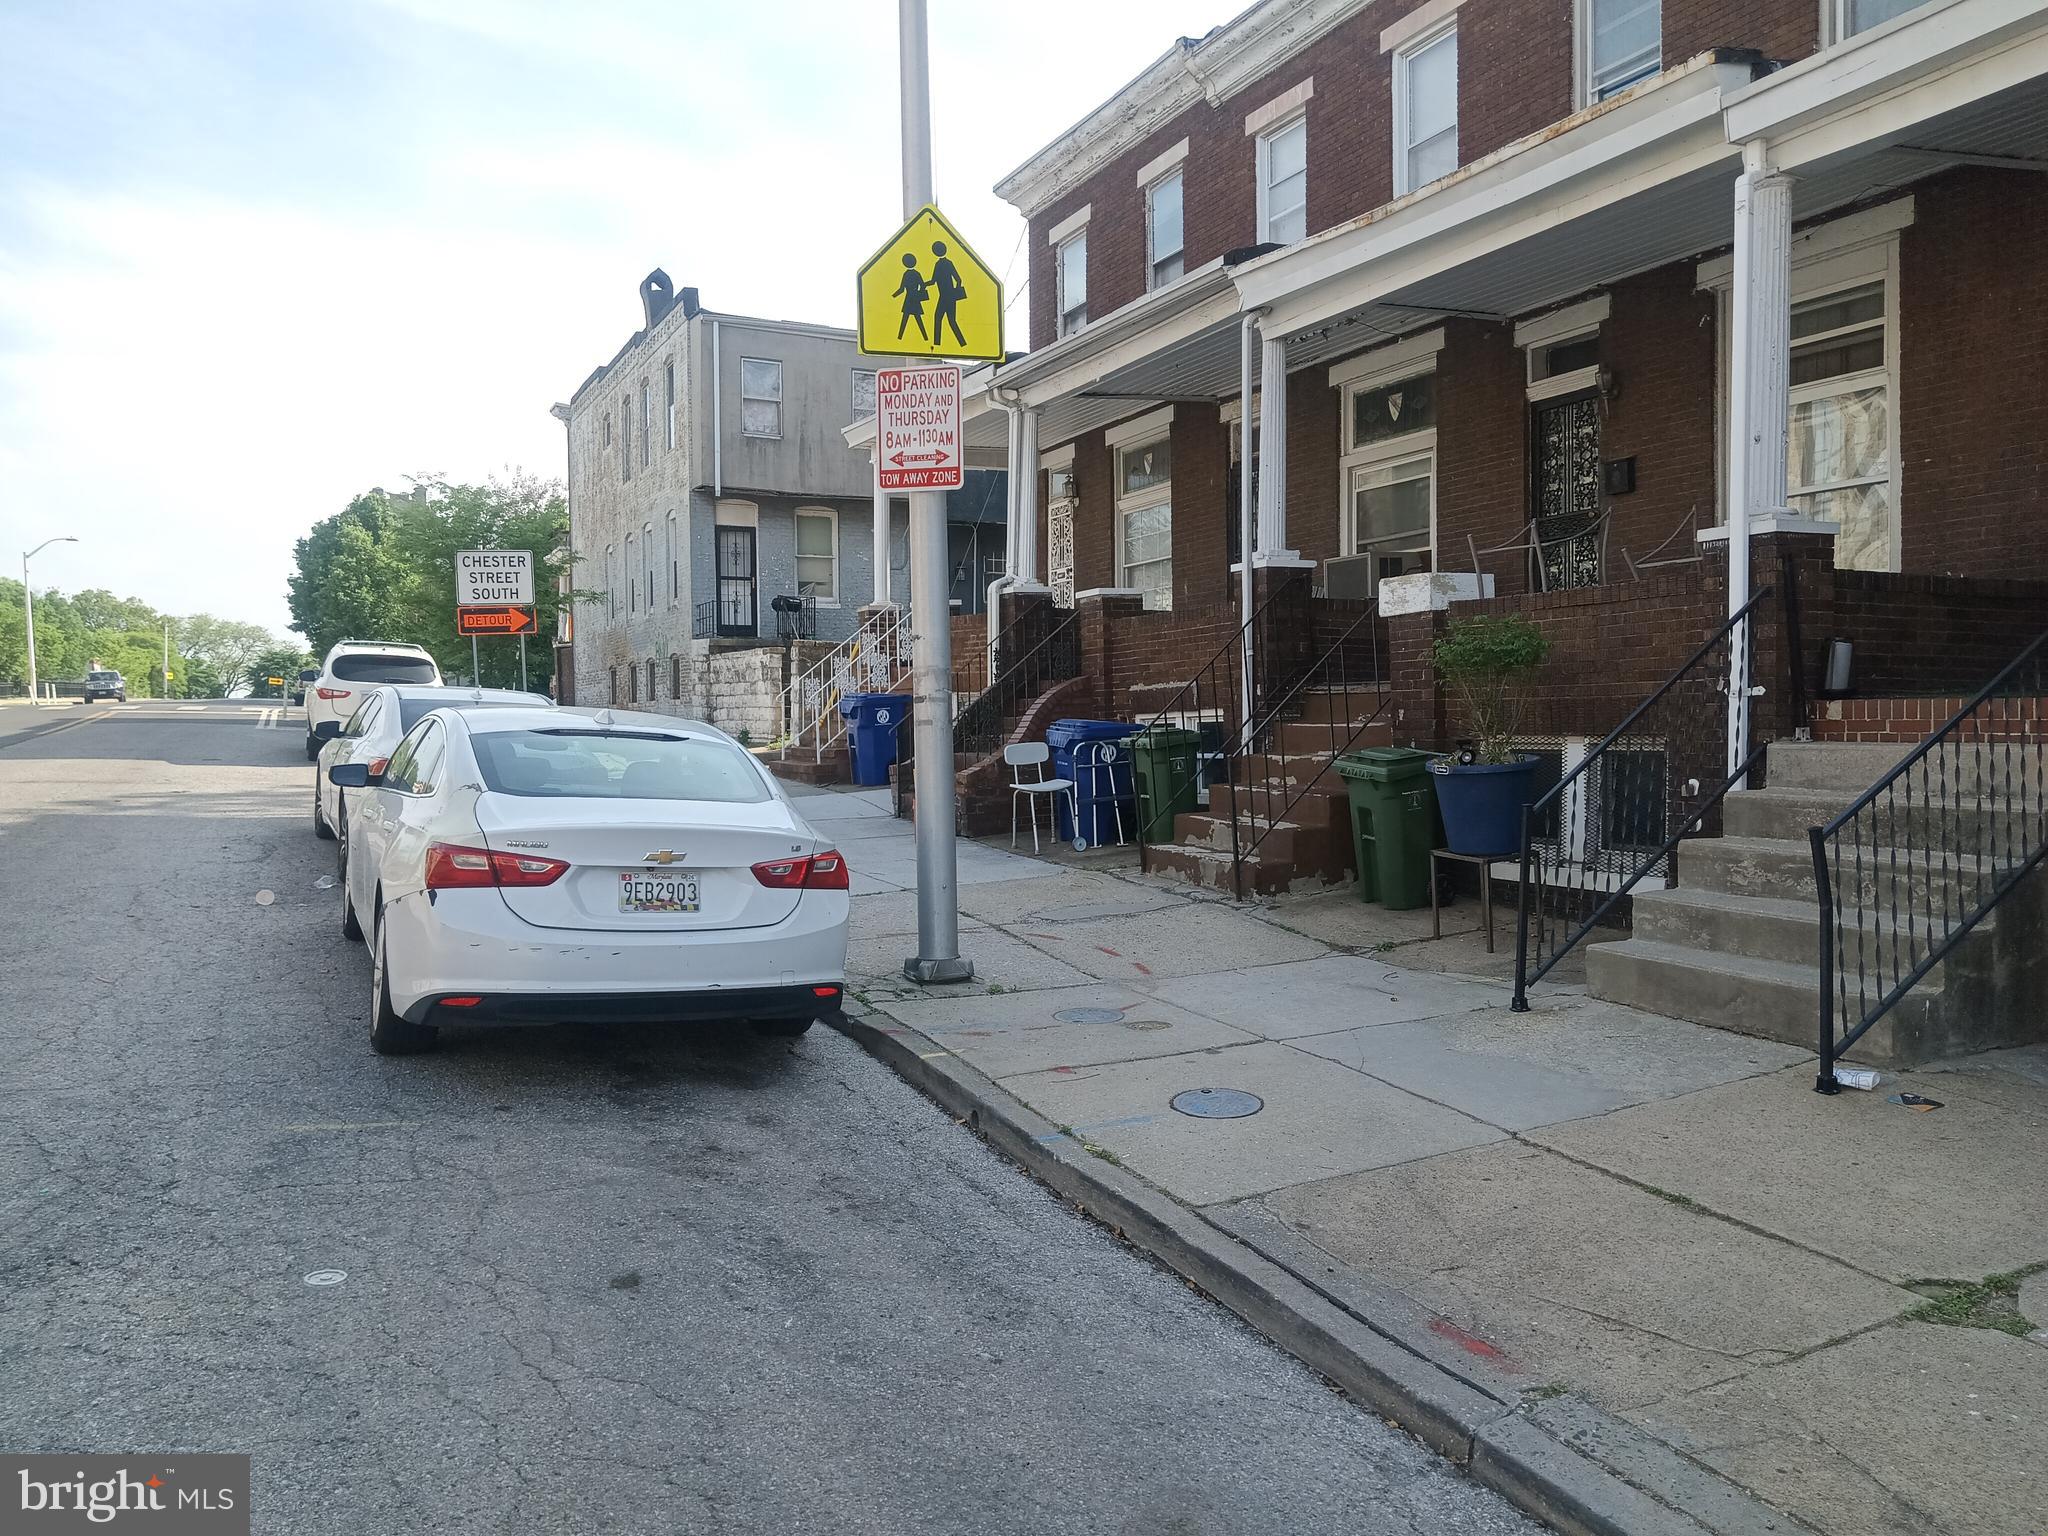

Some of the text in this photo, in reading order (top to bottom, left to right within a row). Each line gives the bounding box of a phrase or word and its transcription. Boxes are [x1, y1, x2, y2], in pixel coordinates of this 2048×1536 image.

[880, 372, 955, 392] NO PARKING
[884, 393, 953, 410] MONDAY AND
[888, 409, 950, 427] THURSDAY
[895, 455, 915, 463] STREET
[881, 470, 958, 486] TOW AWAY ZONE
[462, 556, 526, 568] CHESTER
[469, 572, 520, 584] STREET
[472, 588, 519, 600] SOUTH
[467, 615, 512, 626] DETOUR
[624, 882, 697, 904] 9EB2903
